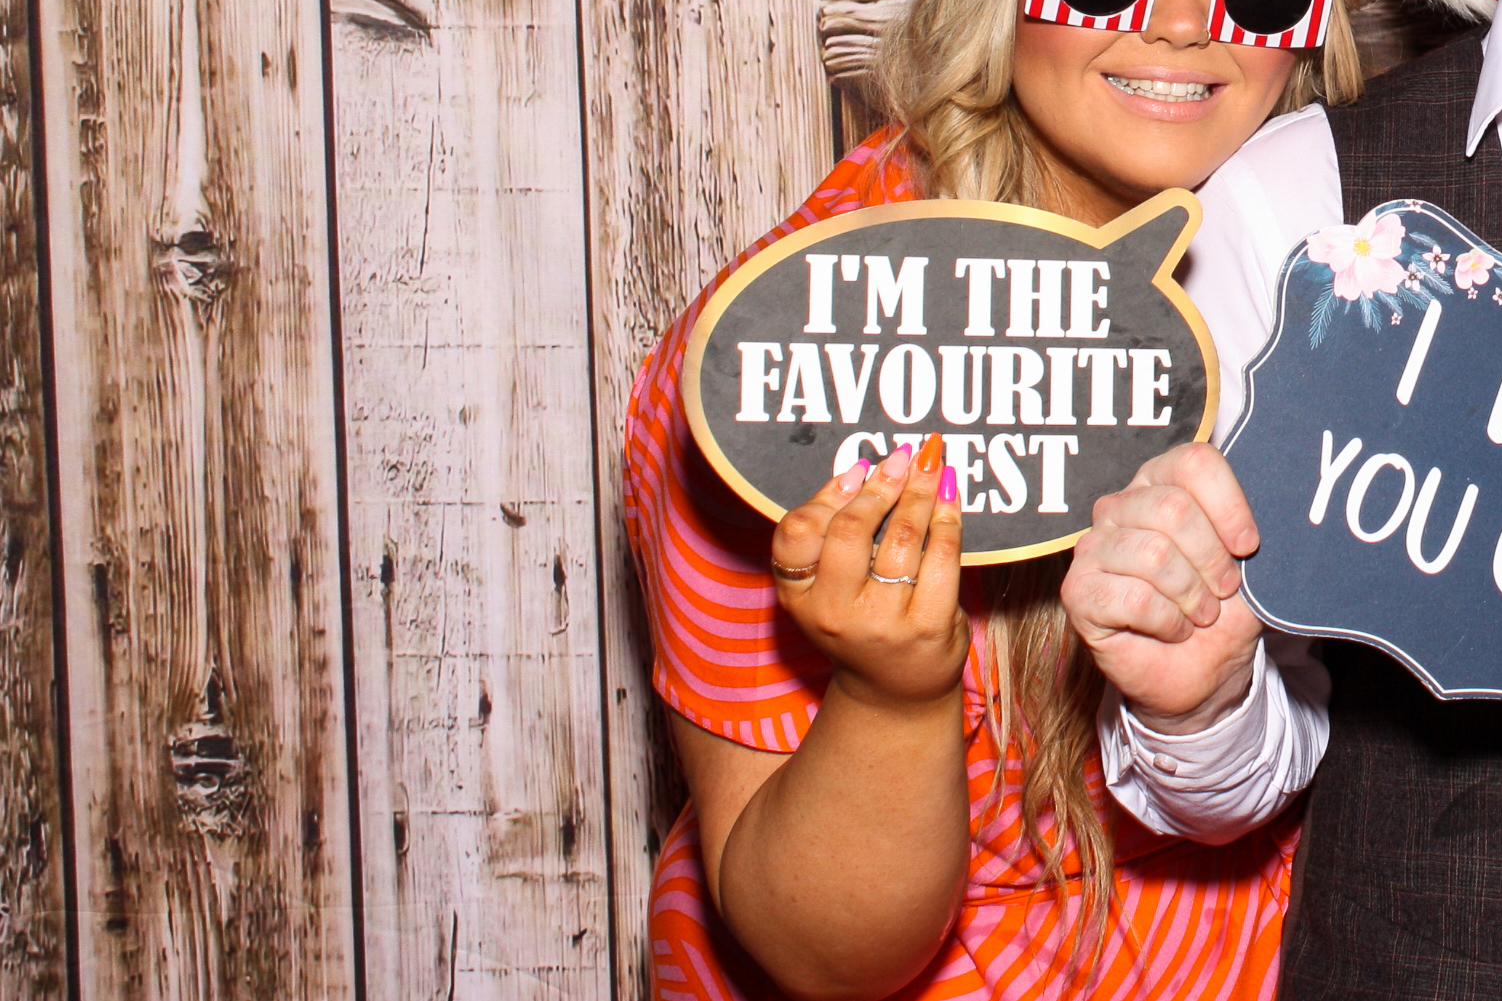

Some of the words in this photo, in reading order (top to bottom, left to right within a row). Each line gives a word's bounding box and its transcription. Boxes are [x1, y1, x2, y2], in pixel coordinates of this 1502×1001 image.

[803, 254, 929, 336] I'M
[955, 258, 1111, 338] THE
[735, 341, 1173, 426] FAVOURITE
[1396, 299, 1442, 405] I
[1308, 429, 1479, 574] YOU
